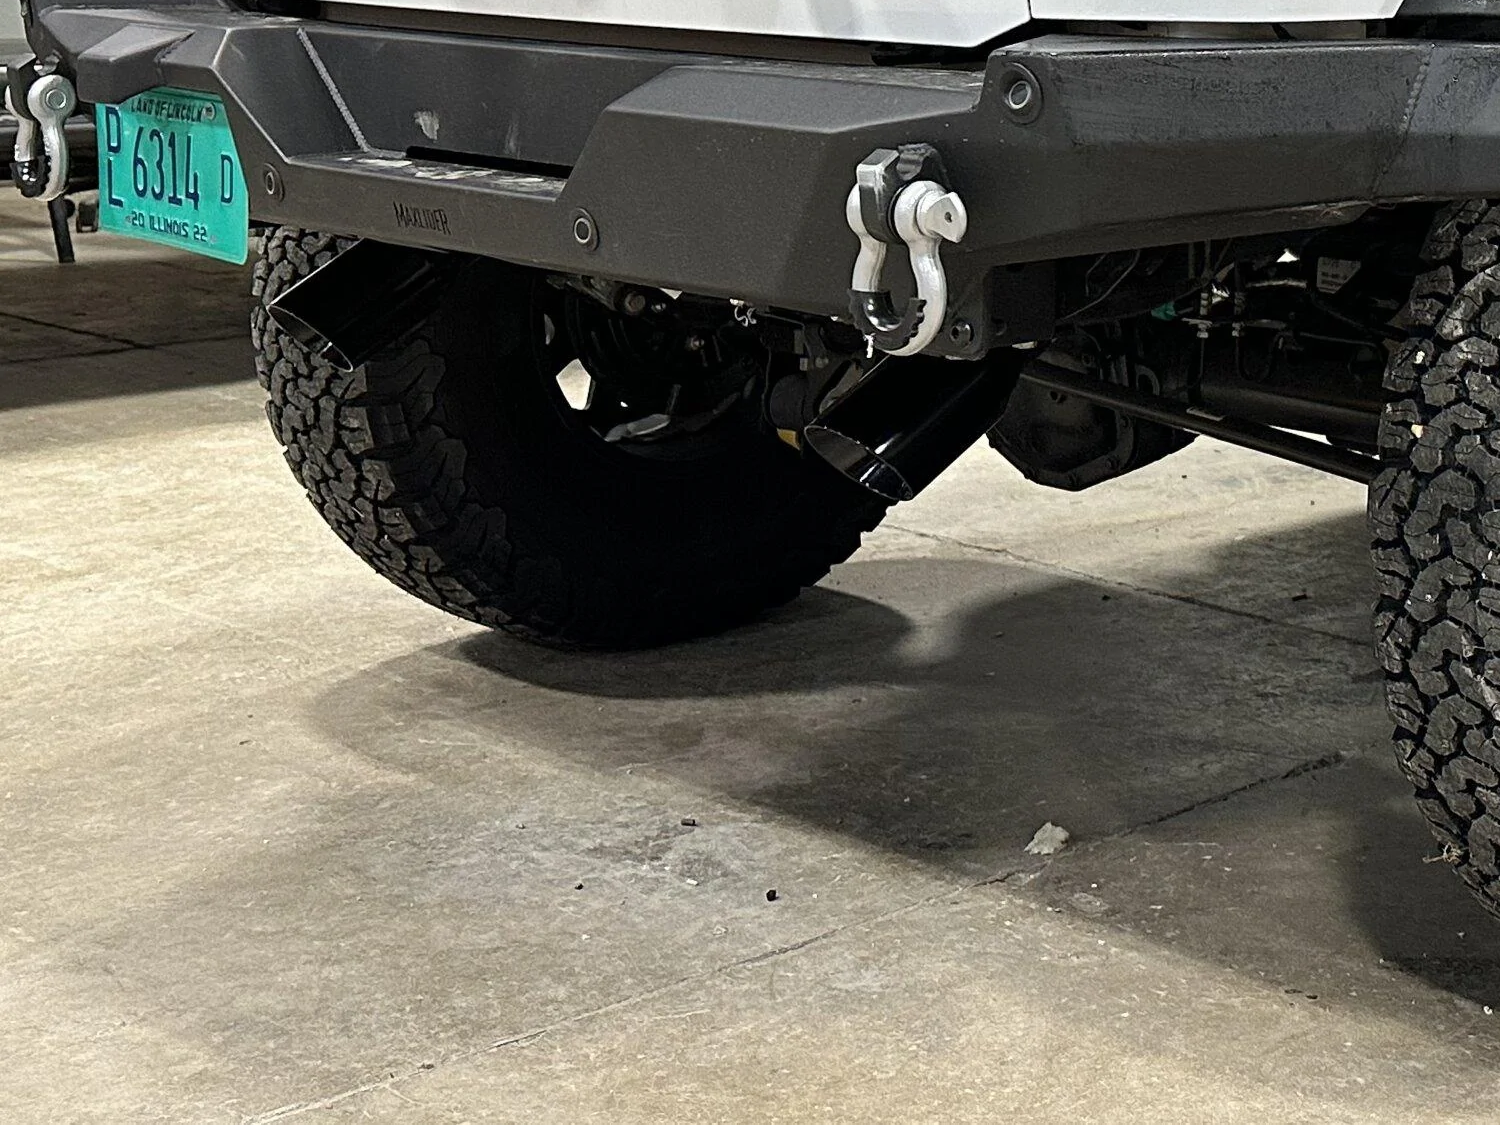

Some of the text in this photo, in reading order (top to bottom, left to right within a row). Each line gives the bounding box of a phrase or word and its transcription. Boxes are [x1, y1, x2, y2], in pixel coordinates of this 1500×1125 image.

[132, 126, 200, 210] 6314
[220, 153, 234, 204] D
[131, 211, 207, 242] 20 ILLINOIS 22
